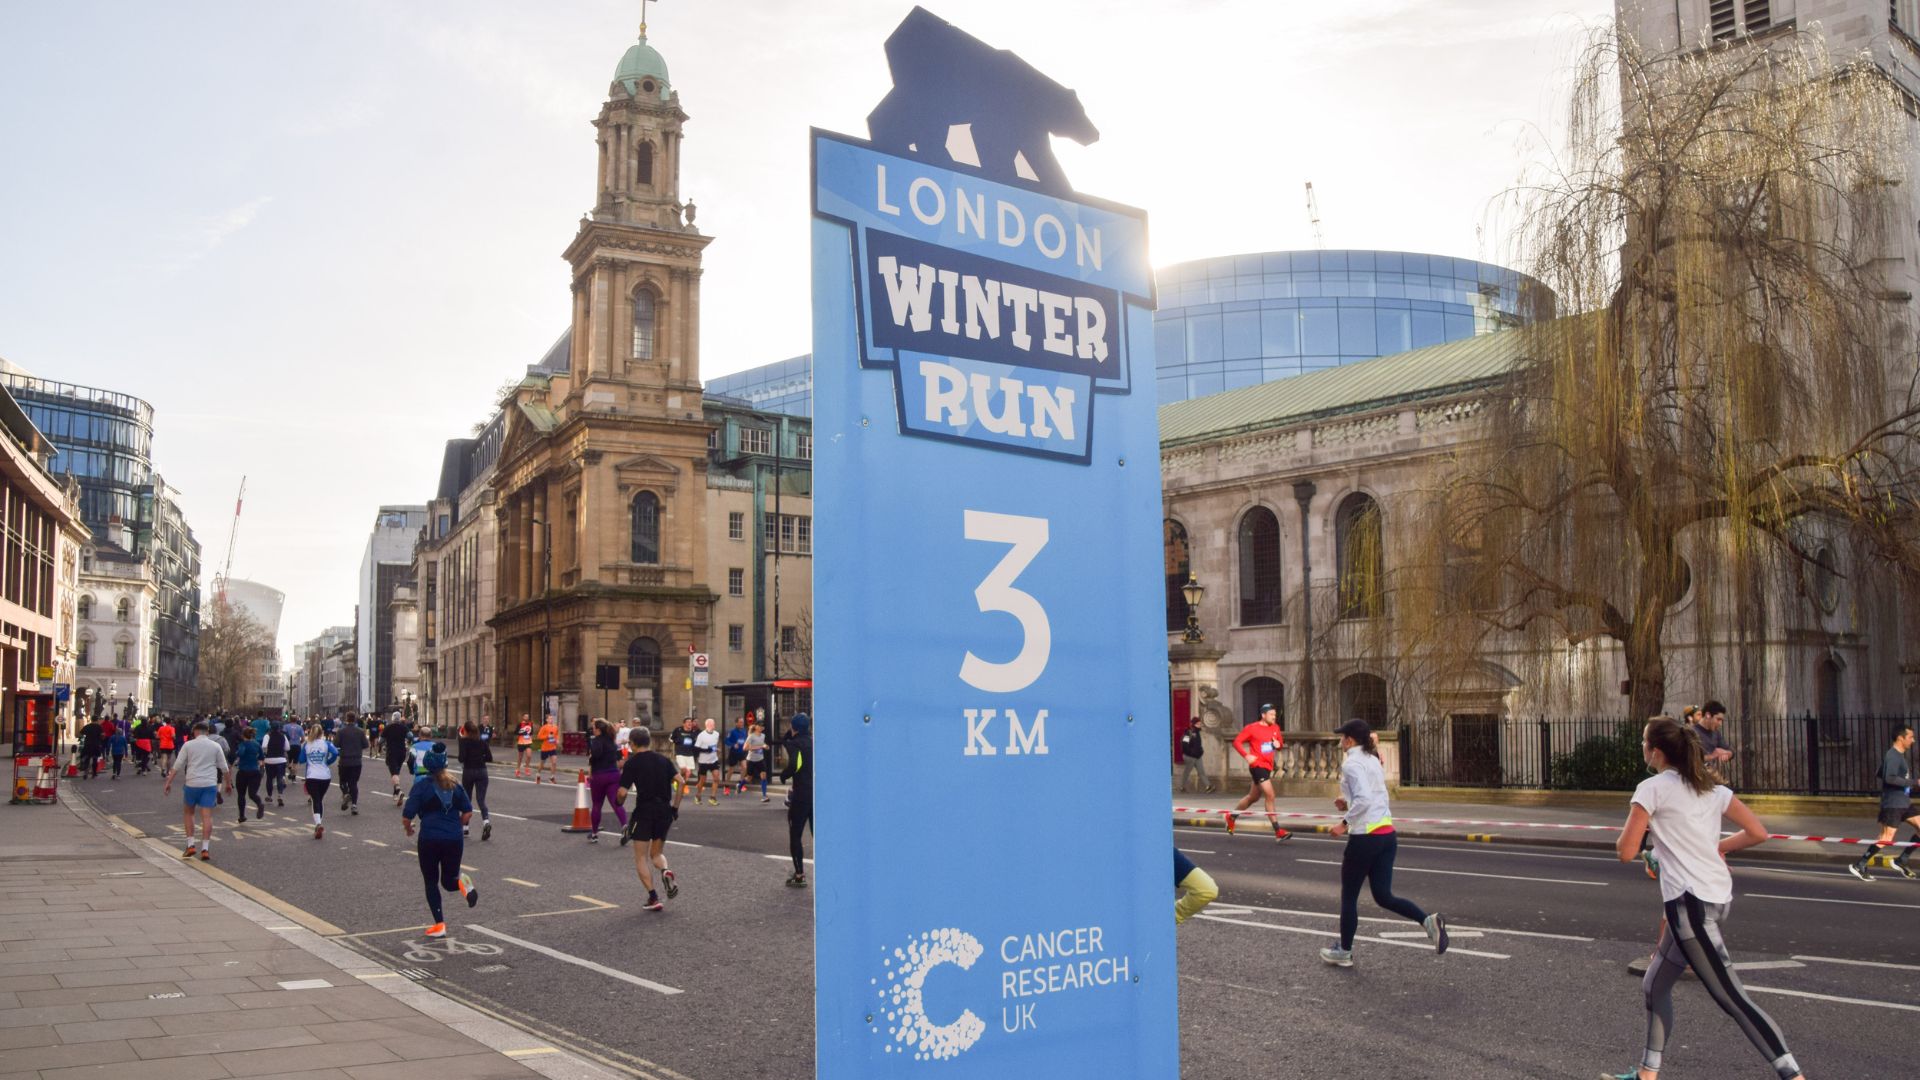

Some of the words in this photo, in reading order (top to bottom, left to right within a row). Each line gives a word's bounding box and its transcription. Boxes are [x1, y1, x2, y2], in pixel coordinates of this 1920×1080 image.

[877, 164, 1103, 272] LONDON
[878, 256, 1109, 363] WINTER
[919, 361, 1075, 441] RUN
[958, 509, 1051, 693] 3
[963, 709, 1049, 756] KM
[1000, 926, 1103, 963] CANCER
[1002, 956, 1129, 999] RESEARCH
[1003, 1002, 1037, 1033] UK
